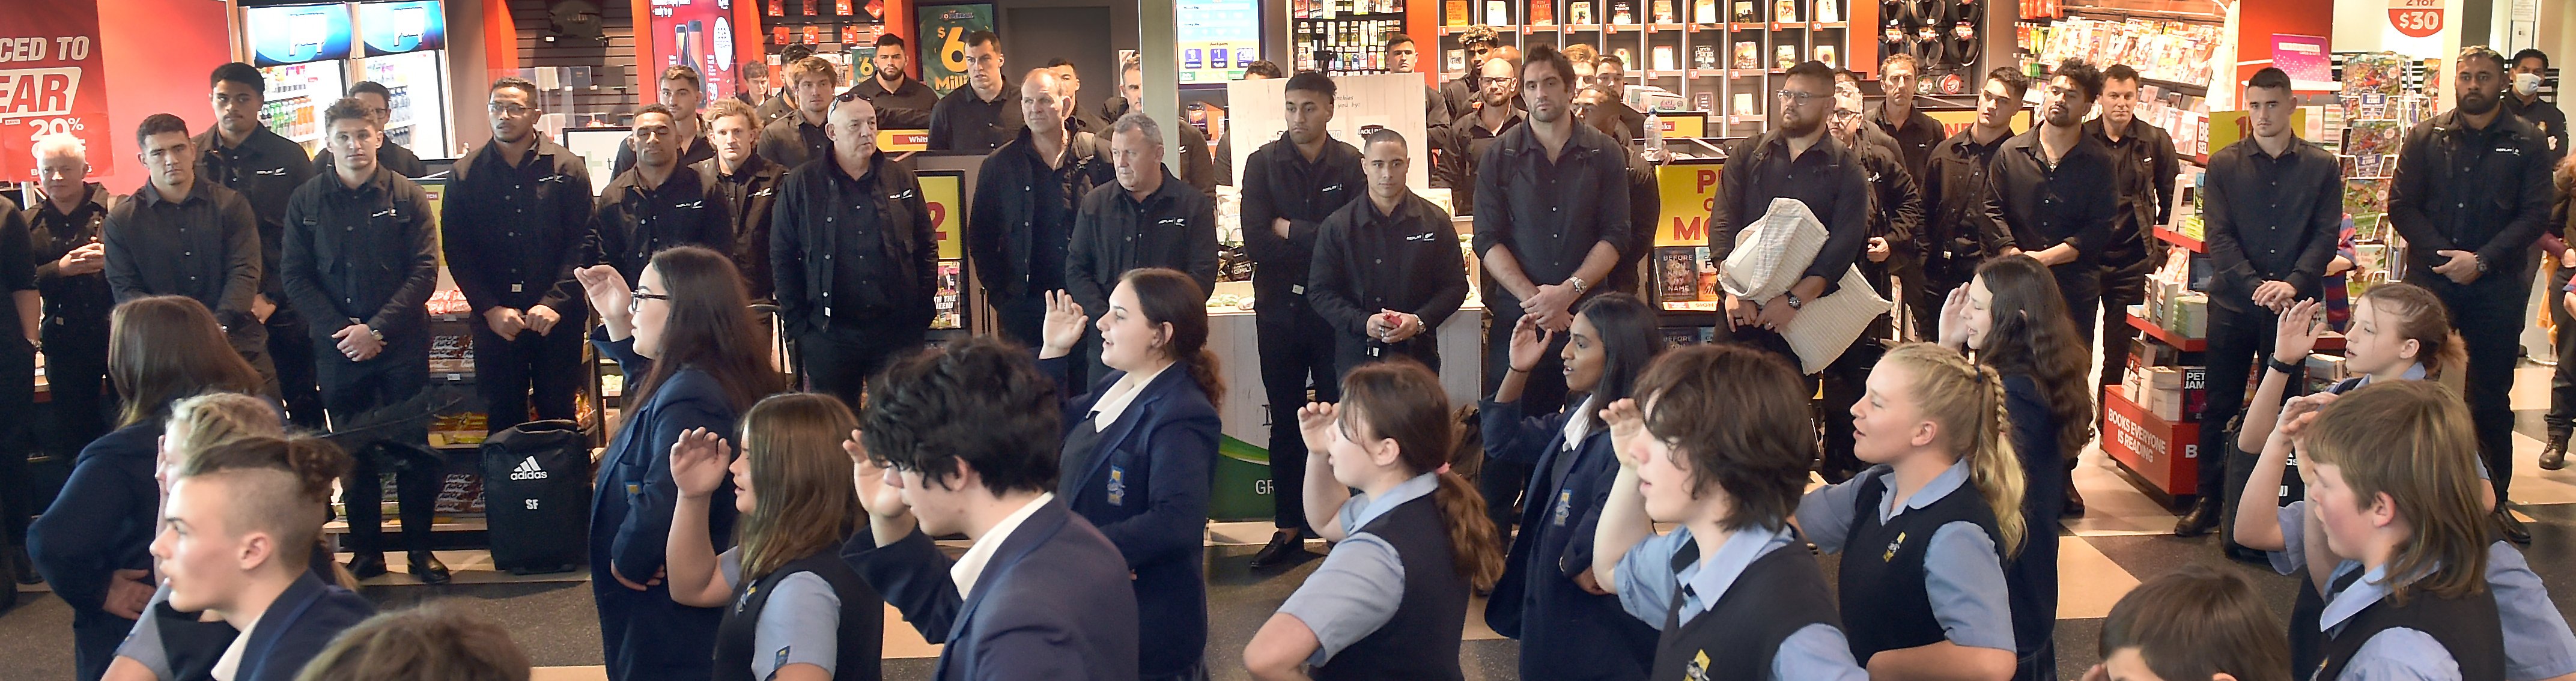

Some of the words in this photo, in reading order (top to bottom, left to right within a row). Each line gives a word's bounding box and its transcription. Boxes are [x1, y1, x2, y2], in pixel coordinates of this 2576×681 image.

[2399, 11, 2439, 30] $30
[56, 36, 90, 61] TO
[29, 117, 84, 142] 20%
[2184, 381, 2205, 389] JAM
[2108, 408, 2130, 432] BOOKS
[2131, 422, 2166, 455] EVERYONE
[2117, 429, 2124, 444] IS
[2124, 434, 2154, 463] READING
[2185, 444, 2198, 458] B
[510, 470, 548, 480] adidas
[525, 499, 539, 510] SF
